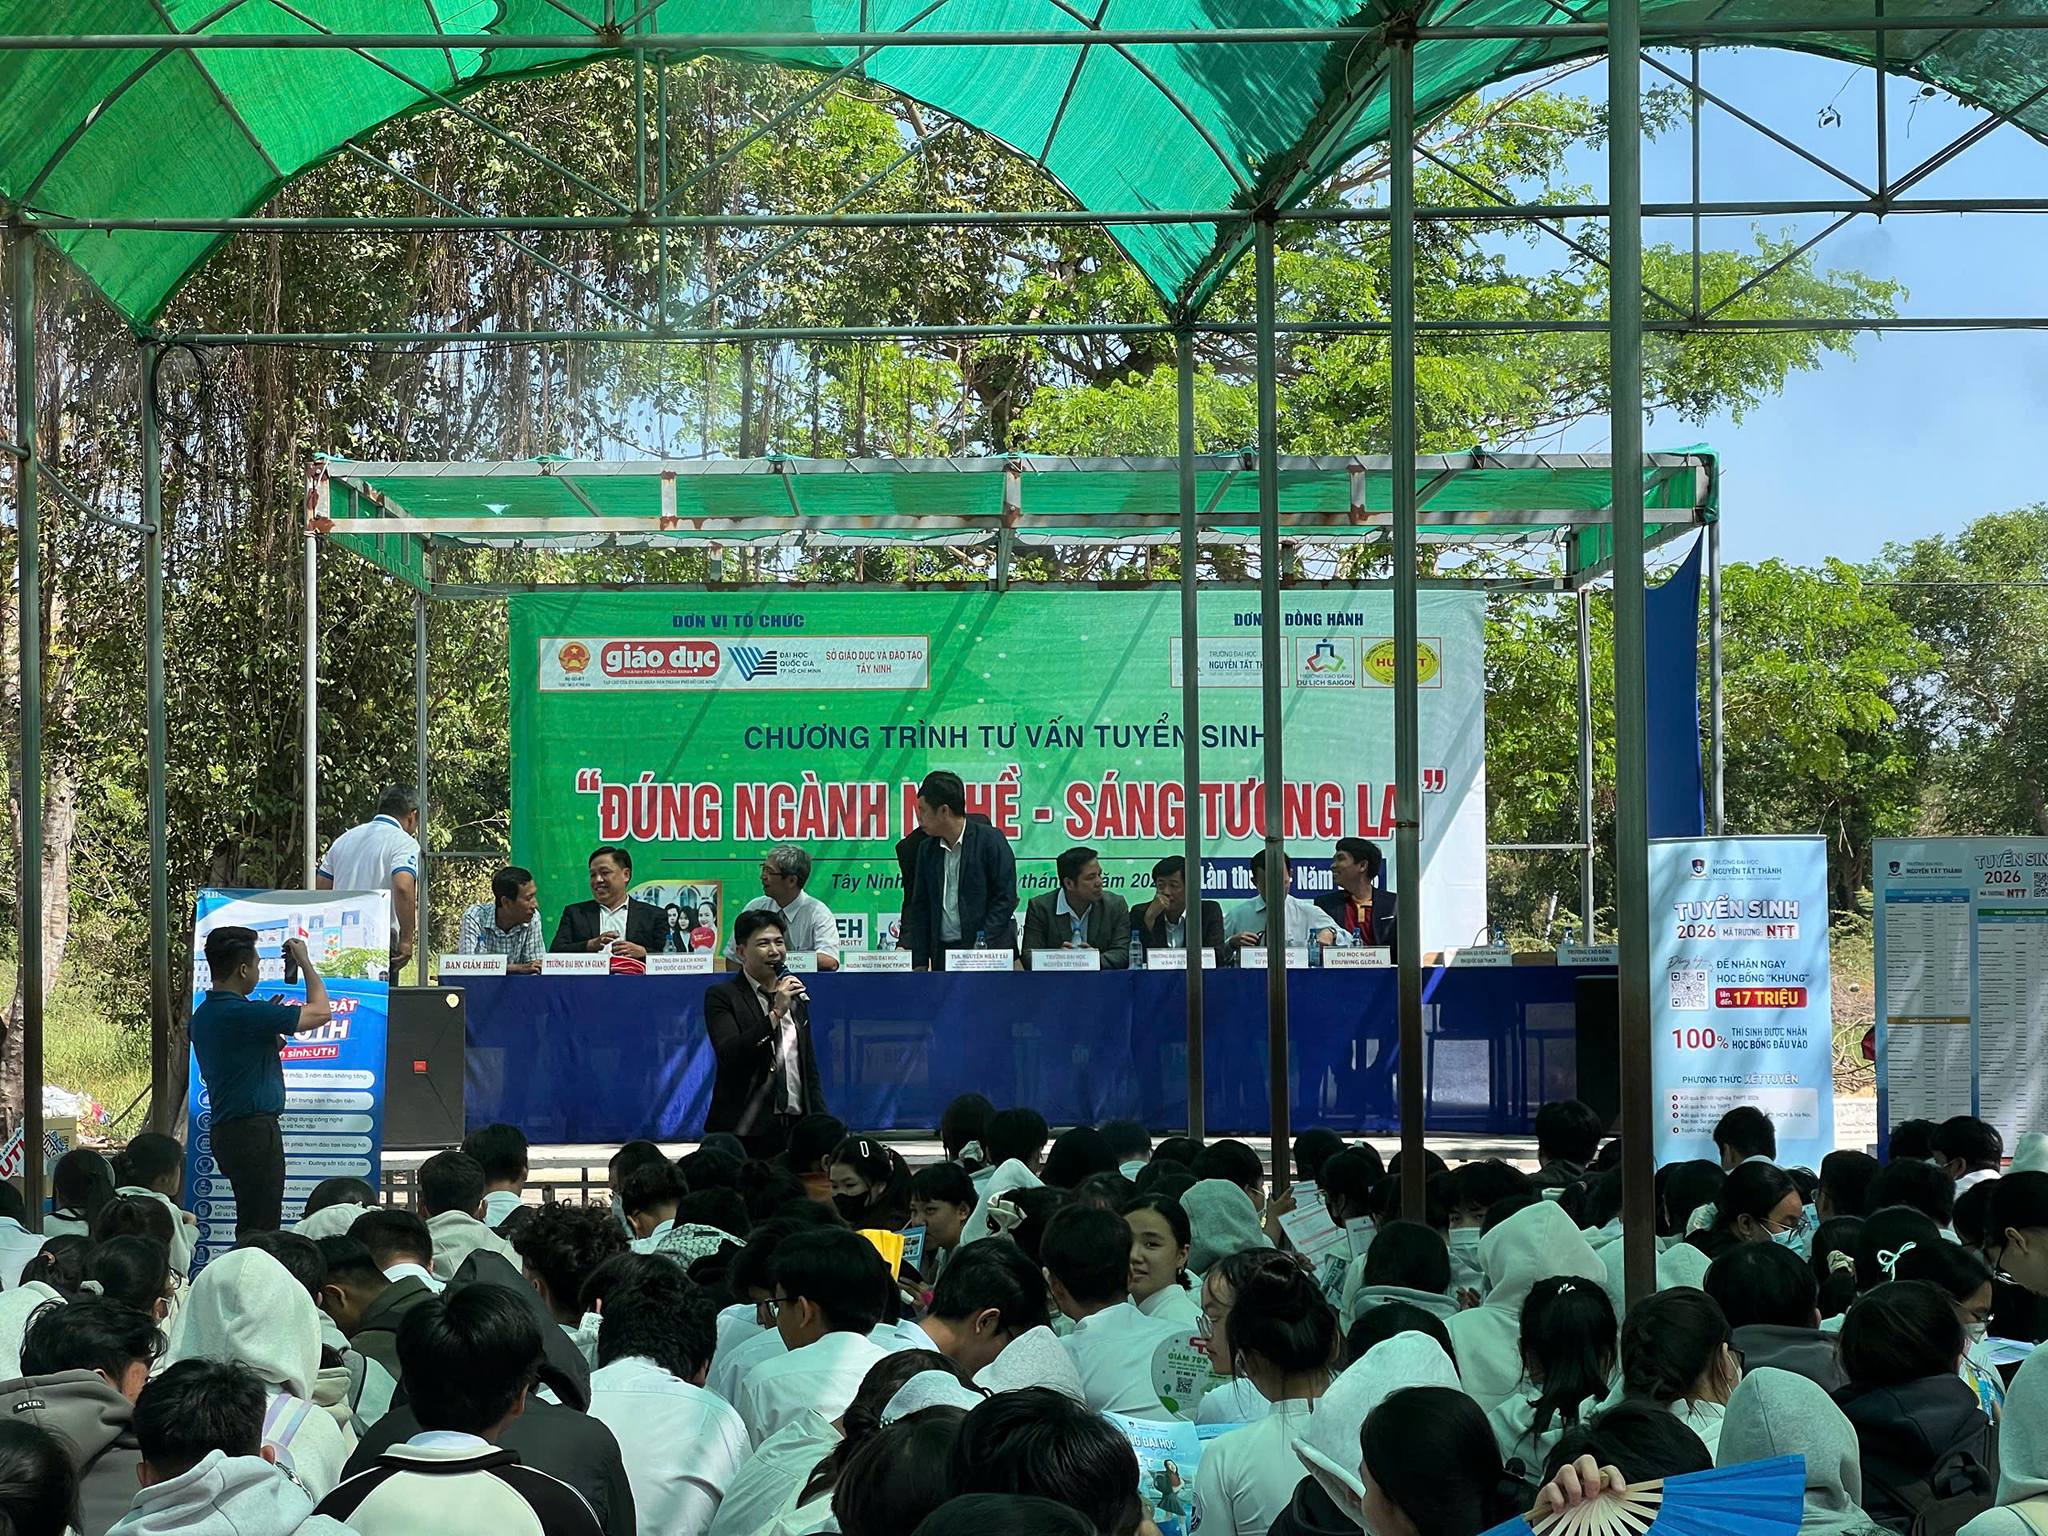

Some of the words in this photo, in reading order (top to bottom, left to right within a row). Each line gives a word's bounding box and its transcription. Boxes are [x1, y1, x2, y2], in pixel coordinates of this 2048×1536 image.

[711, 614, 728, 631] VỊ
[733, 611, 754, 628] TỔ
[760, 612, 805, 628] CHỨC
[1285, 609, 1322, 626] ĐỒNG
[1327, 611, 1364, 626] HÀNH
[606, 643, 664, 672] giáo
[669, 646, 716, 673] dục
[826, 648, 836, 660] SỞ
[838, 649, 857, 660] GIÁO
[860, 651, 875, 662] DỤC
[877, 649, 887, 660] VÀ
[889, 649, 906, 660] ĐÀO
[907, 651, 922, 662] TẠO
[856, 663, 872, 674] TÂY
[874, 665, 892, 674] NINH
[1209, 658, 1237, 669] NGUYỄN
[744, 723, 869, 750] CHƯƠNG
[879, 719, 967, 749] TRÌNH
[978, 721, 1017, 749] TƯ
[1025, 715, 1084, 748] VẤN
[1094, 712, 1185, 748] TUYỂN
[1201, 724, 1264, 748] SINH
[735, 771, 888, 839] NGÀNH
[904, 765, 1019, 838] NHỀ
[1035, 807, 1051, 821] -
[1066, 771, 1185, 839] SÁNG
[1200, 862, 1227, 890] Lần
[1297, 866, 1333, 890] Năm
[1712, 866, 1740, 874] NGUYỄN
[1743, 866, 1755, 874] TẤT
[1758, 866, 1782, 874] THÀNH
[1984, 870, 2021, 884] 2026
[831, 873, 861, 892] Tây
[1021, 872, 1058, 888] thán
[1102, 873, 1124, 888] ăm
[2006, 888, 2027, 898] NTT
[1747, 899, 1799, 920] SINH
[836, 919, 862, 938] EH
[1677, 924, 1716, 938] 2026
[1766, 925, 1795, 937] NTT
[445, 961, 461, 969] BAN
[462, 960, 482, 969] GIÁM
[483, 960, 500, 970] HIỆU
[592, 960, 607, 968] GIANG
[1731, 958, 1759, 972] NHẬN
[1761, 960, 1787, 969] NGAY
[1717, 974, 1737, 984] HỌC
[1734, 991, 1752, 1005] 17
[1754, 988, 1799, 1008] TRIỆU
[1746, 1027, 1763, 1036] SINH
[1732, 1041, 1749, 1050] HỌC
[1792, 1038, 1808, 1049] VÀO
[1682, 1075, 1718, 1083] PHƯƠNG
[1720, 1074, 1742, 1083] THỨC
